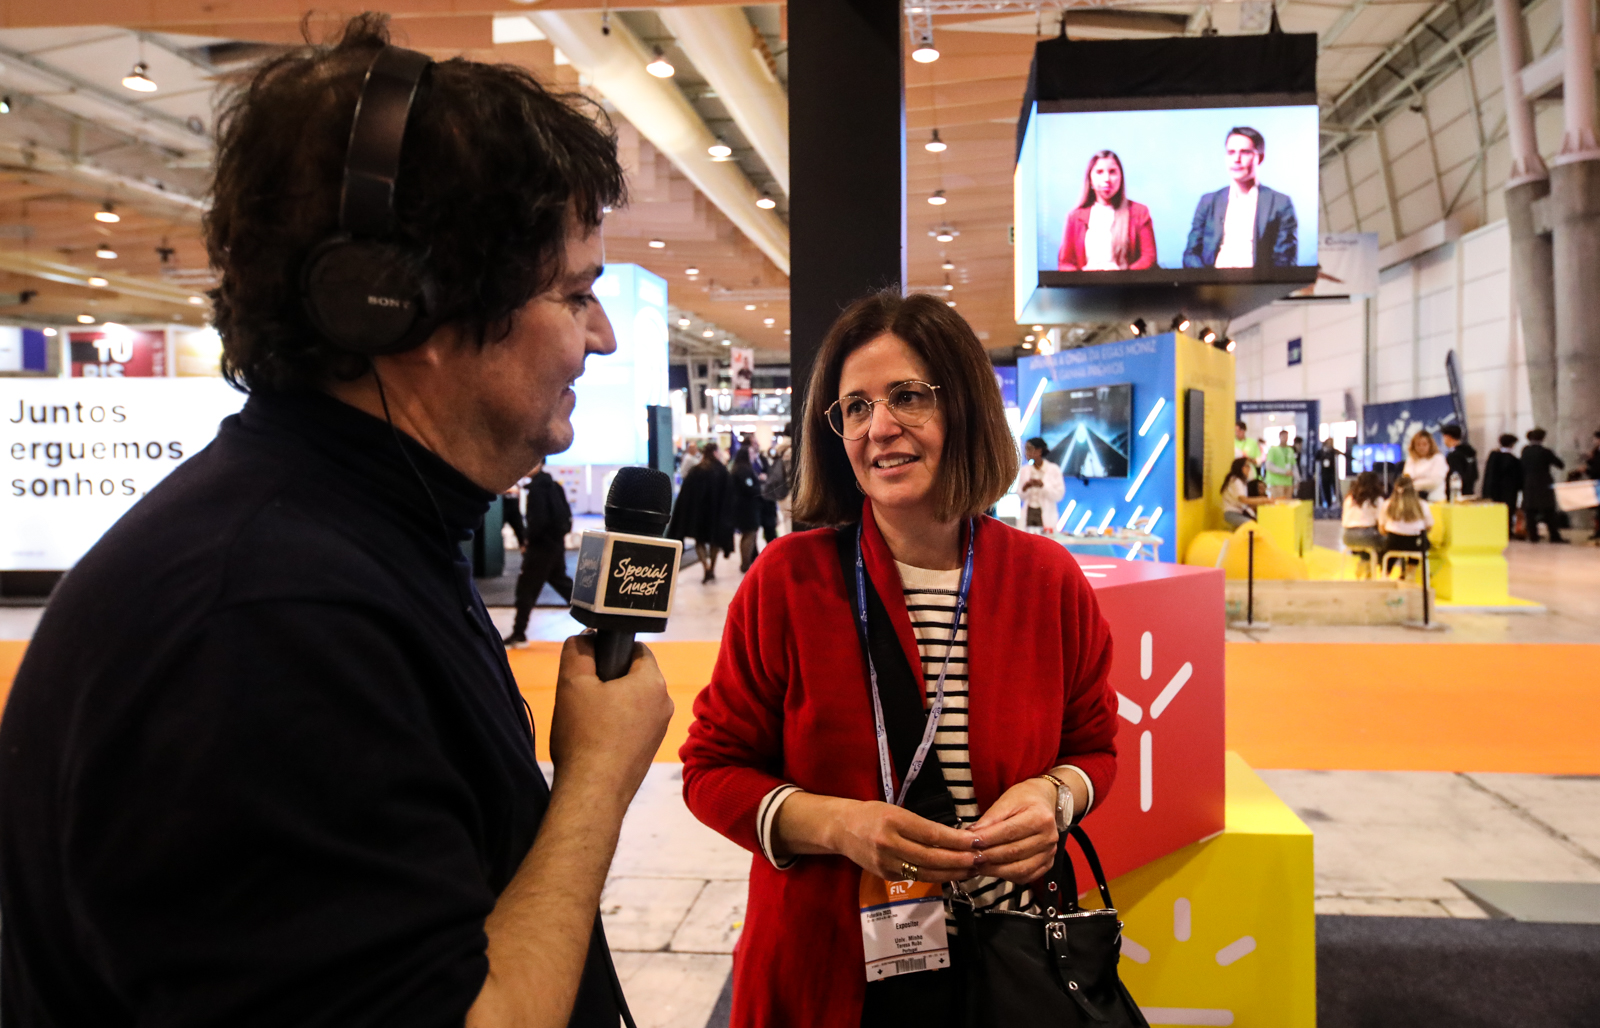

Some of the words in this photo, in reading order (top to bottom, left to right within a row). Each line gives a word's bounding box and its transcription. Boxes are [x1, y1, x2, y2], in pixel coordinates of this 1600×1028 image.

[9, 399, 127, 424] Juntos
[10, 441, 184, 467] erguemos
[613, 557, 668, 580] Special
[619, 576, 665, 596] Guest
[890, 885, 906, 895] FIL
[895, 920, 919, 930] Expositor
